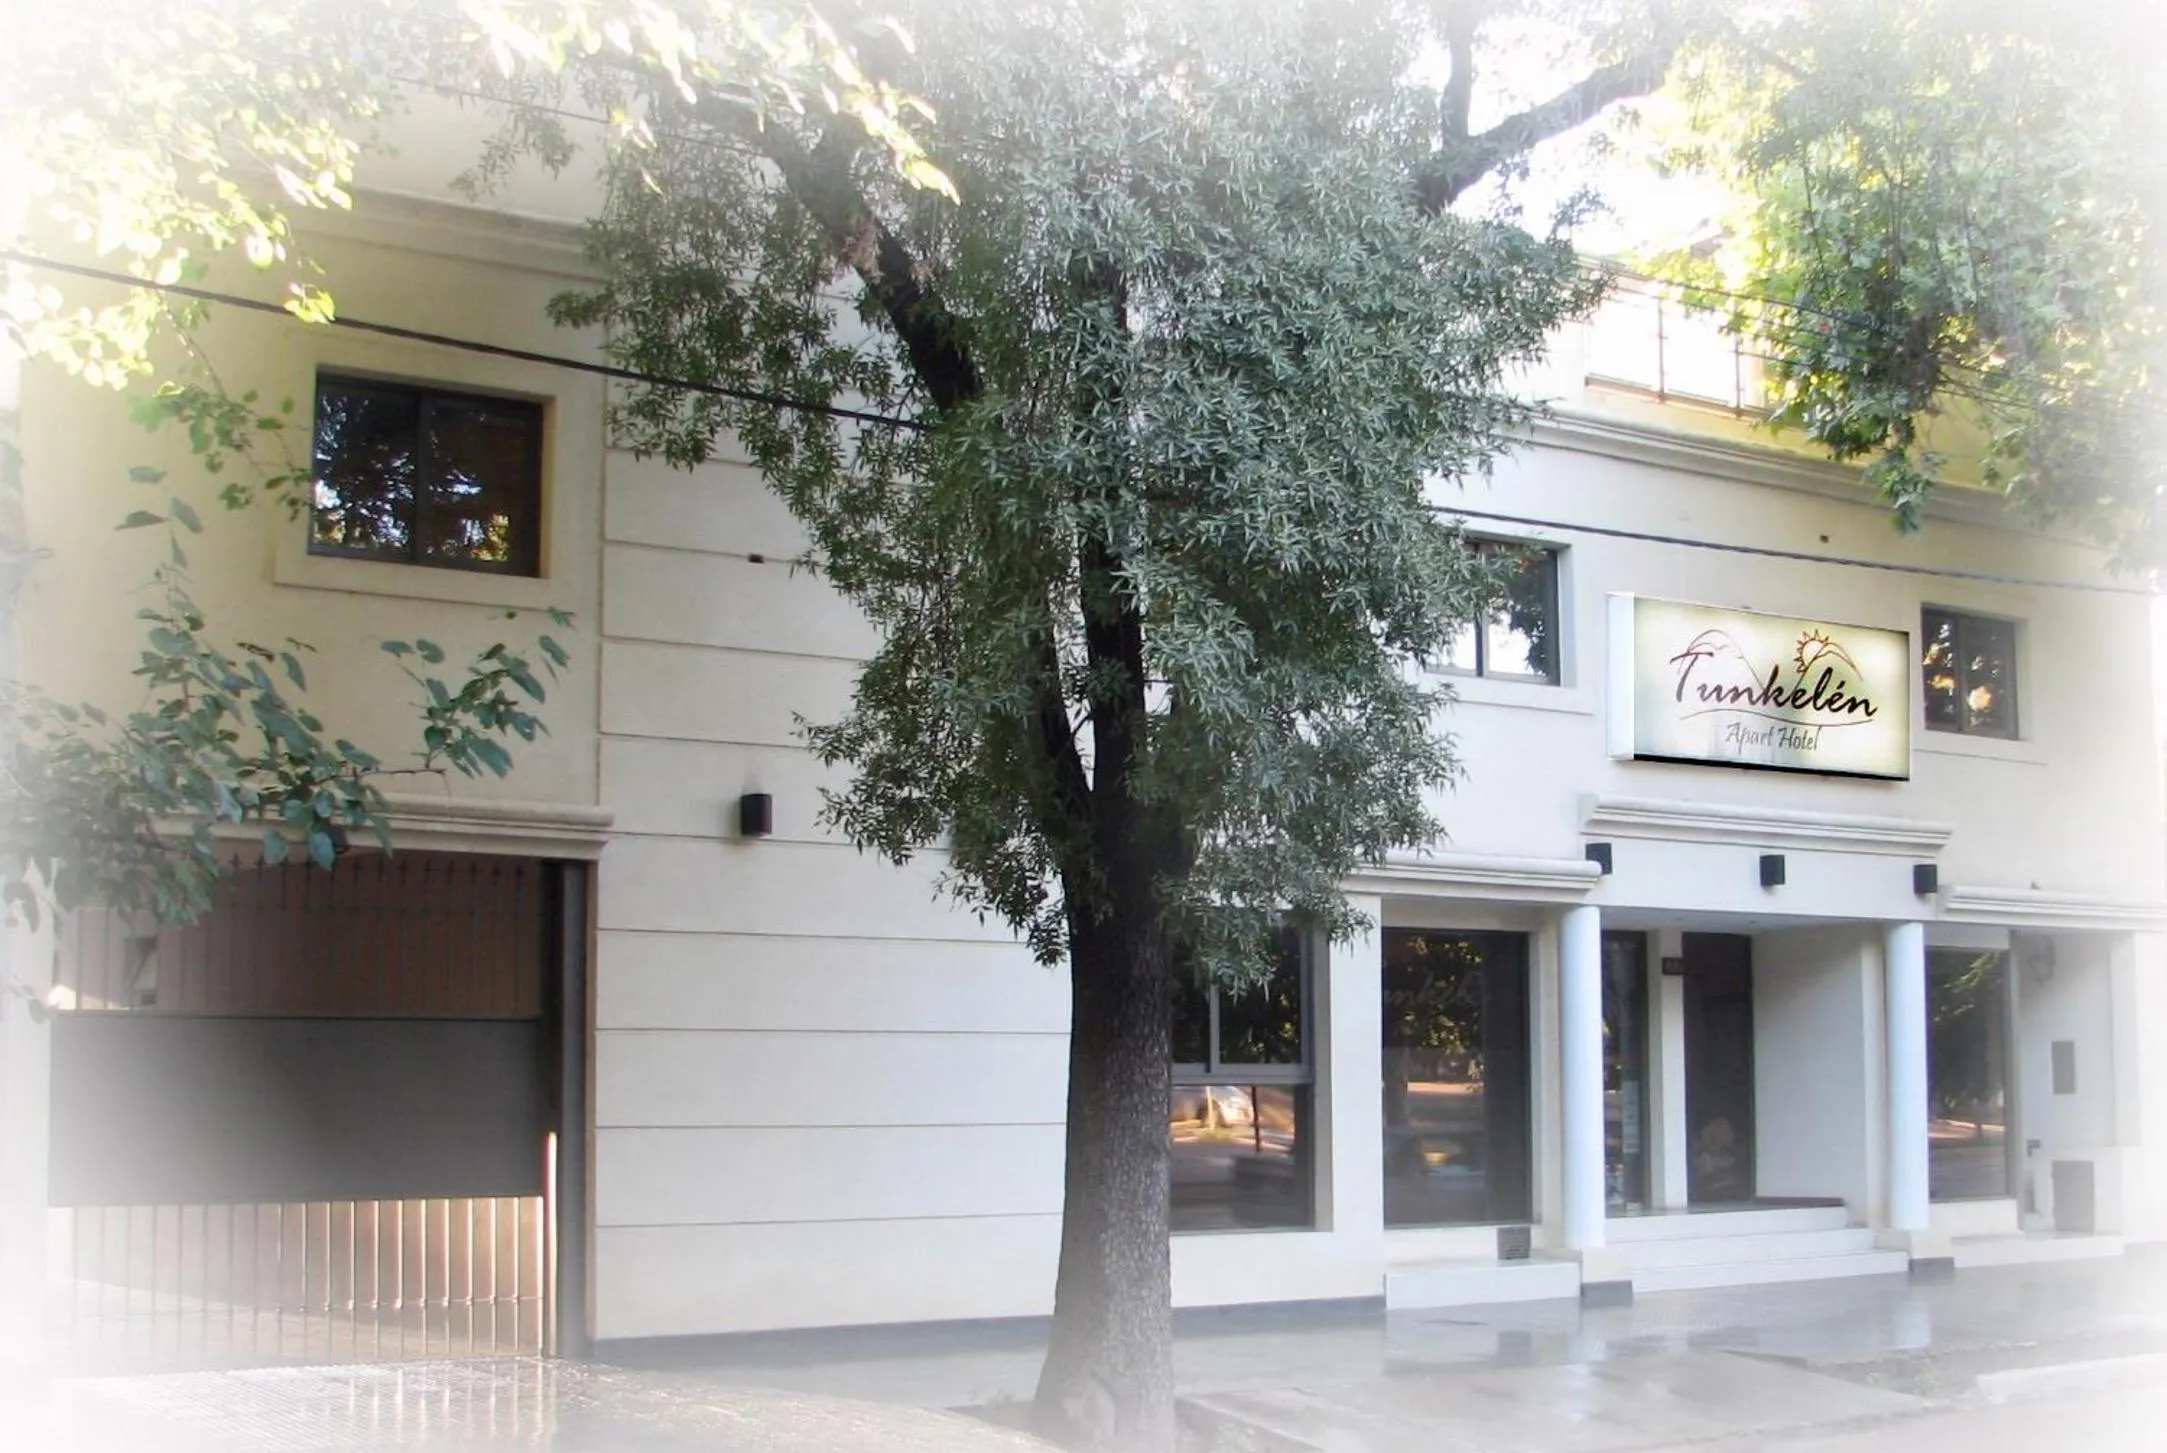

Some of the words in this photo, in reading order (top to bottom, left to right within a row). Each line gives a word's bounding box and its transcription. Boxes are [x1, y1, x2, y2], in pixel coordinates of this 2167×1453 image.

[1669, 652, 1878, 717] Tunkelén
[1725, 722, 1774, 755] Apart
[1778, 725, 1821, 751] Hotel
